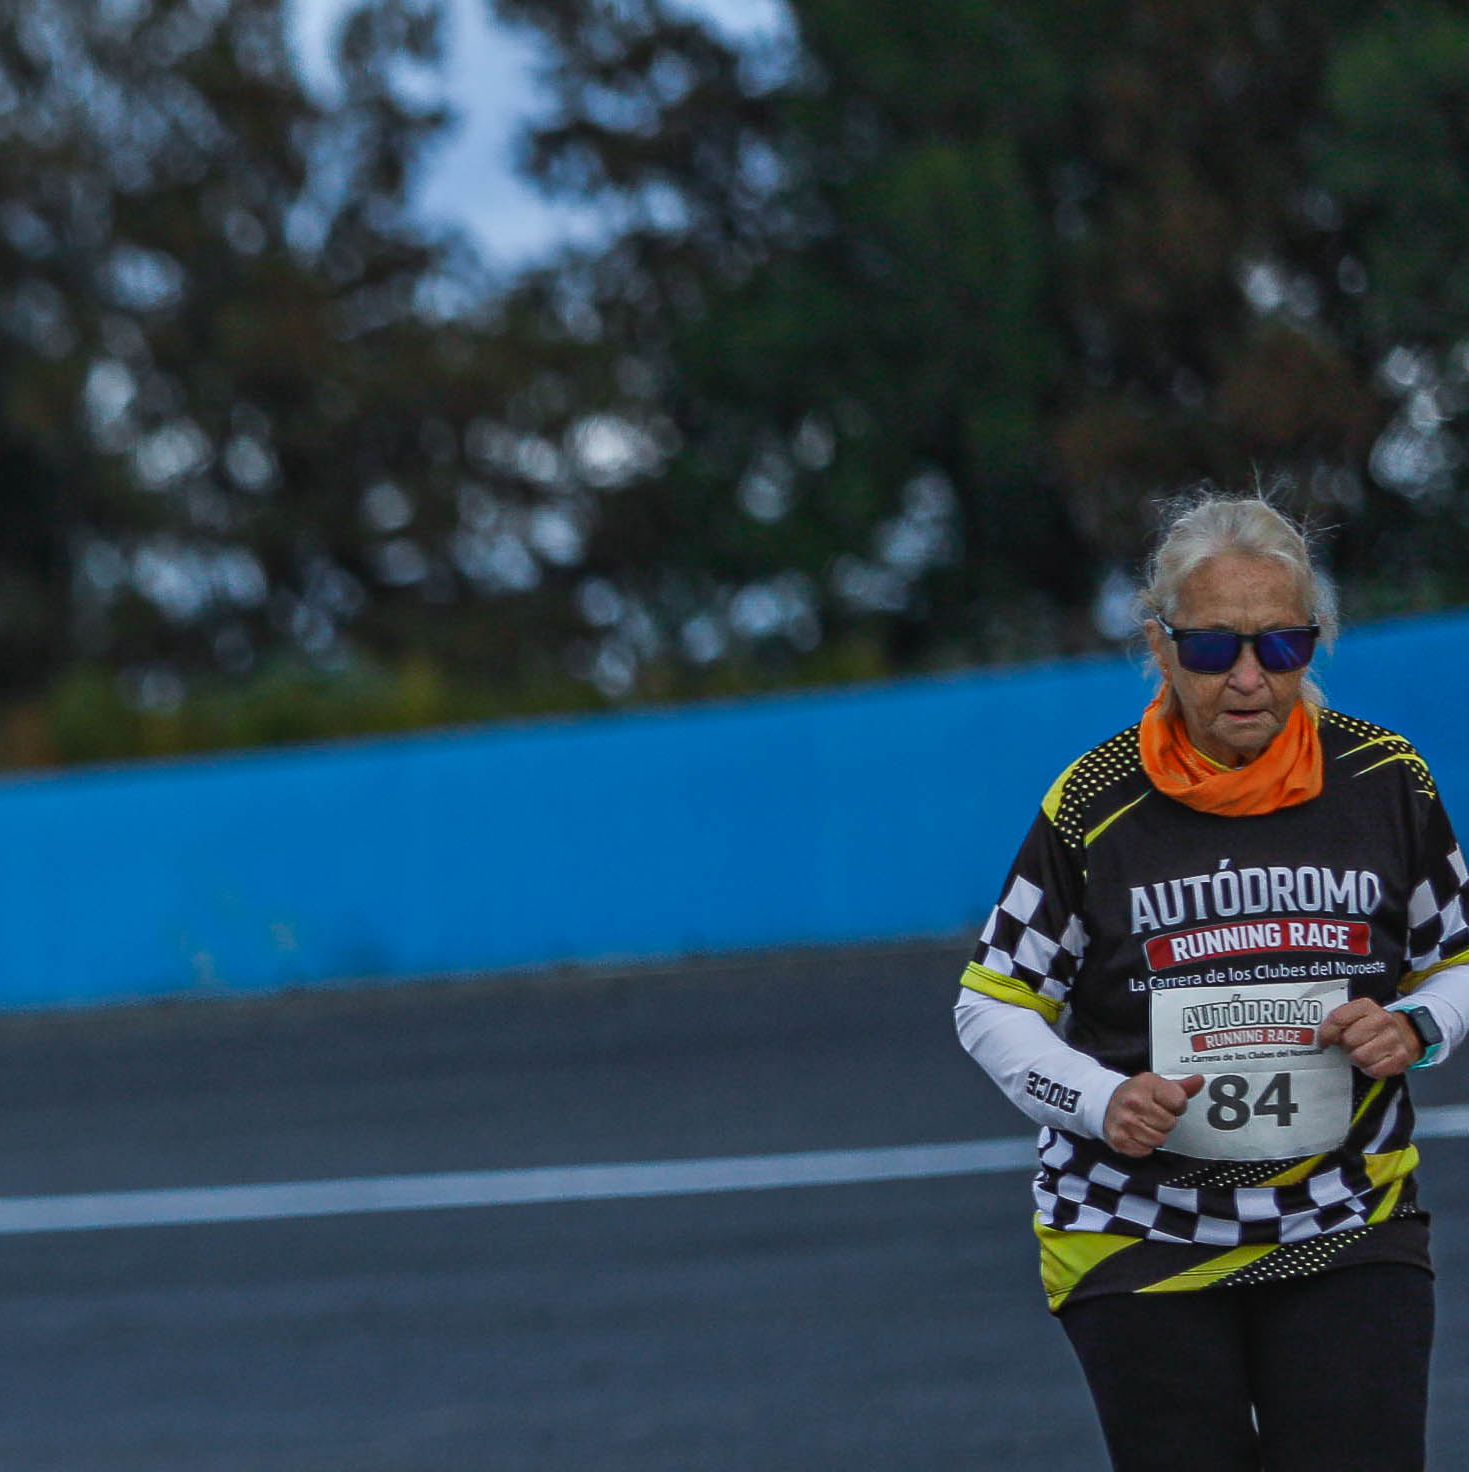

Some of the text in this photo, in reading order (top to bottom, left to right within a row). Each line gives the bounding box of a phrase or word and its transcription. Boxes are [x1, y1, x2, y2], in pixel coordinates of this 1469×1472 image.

[1128, 858, 1382, 934] AUTÓDROMO
[1170, 922, 1350, 962] RUNNING RACE
[1129, 960, 1387, 992] La Carrera de los Clubes del Noroeste
[1182, 994, 1323, 1033] AUTÓDROMO
[1205, 1029, 1300, 1048] RUNNING RACE
[1180, 1056, 1189, 1064] La
[1223, 1053, 1233, 1061] de
[1207, 1072, 1299, 1131] 84
